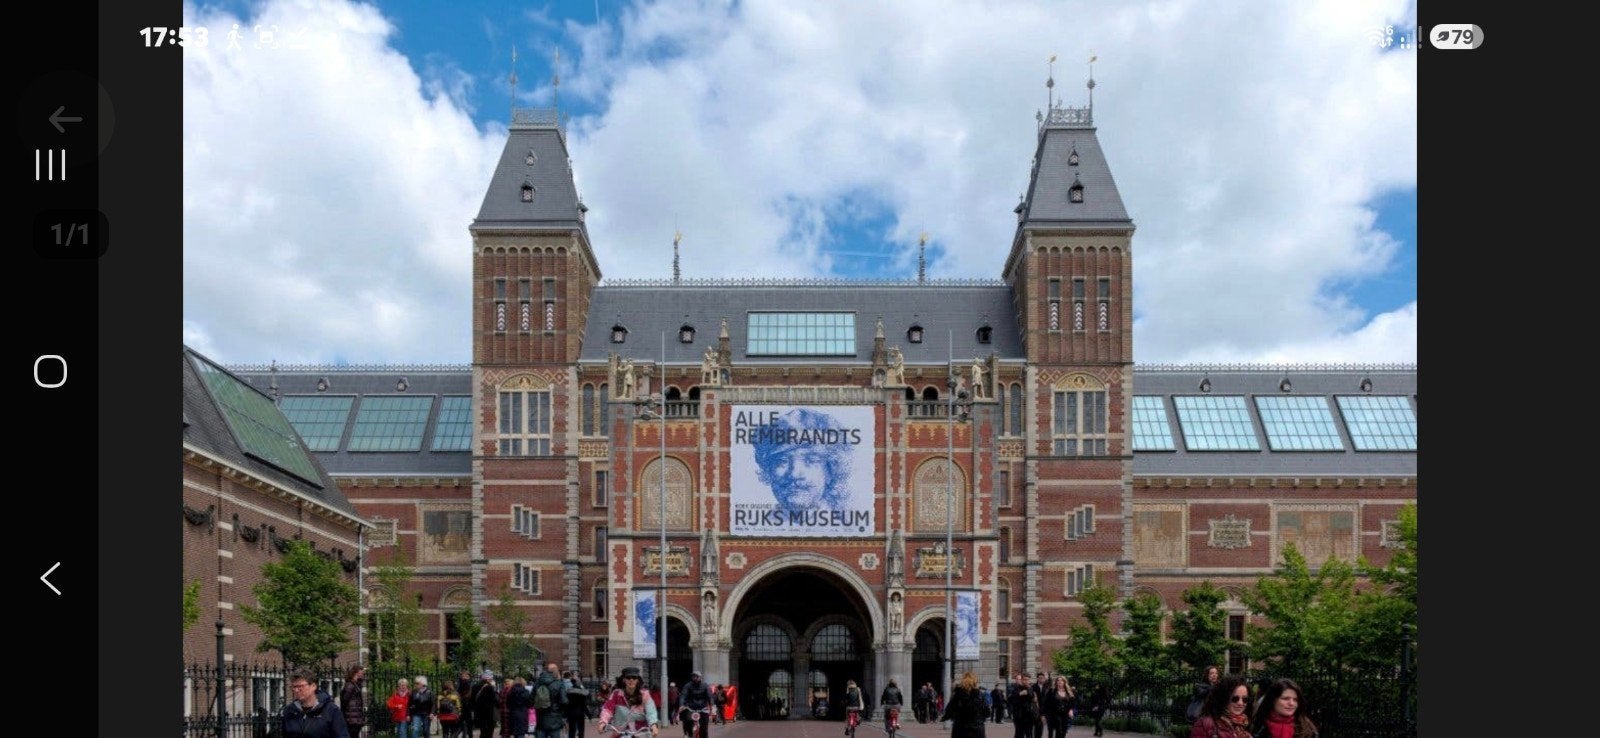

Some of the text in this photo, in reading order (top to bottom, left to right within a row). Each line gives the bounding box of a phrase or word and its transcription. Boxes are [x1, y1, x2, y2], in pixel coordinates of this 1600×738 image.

[735, 411, 780, 427] ALLE
[735, 428, 862, 445] REMBRANDTS
[735, 510, 870, 527] RIJKS MUSEUM
